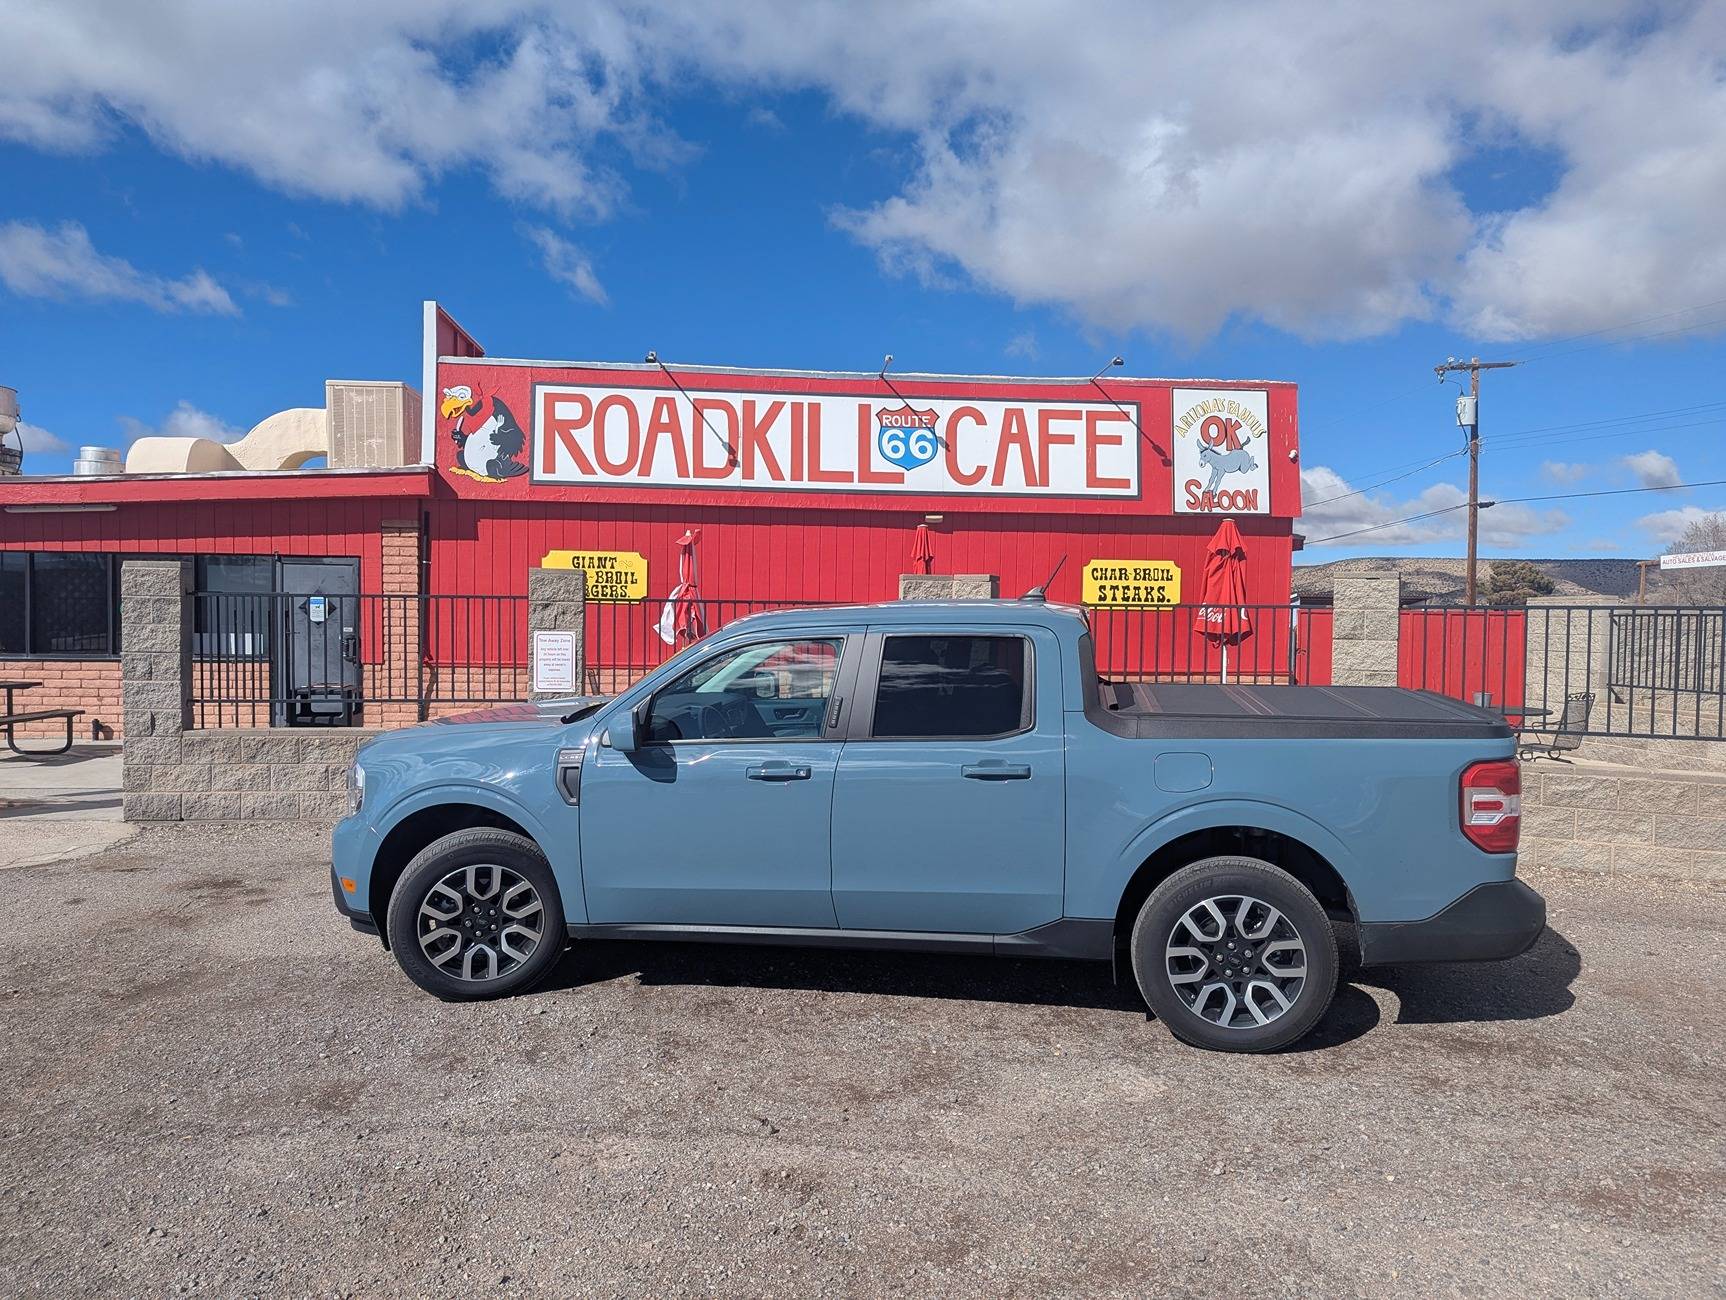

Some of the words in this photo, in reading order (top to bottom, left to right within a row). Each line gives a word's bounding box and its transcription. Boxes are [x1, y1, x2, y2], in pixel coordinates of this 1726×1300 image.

[882, 415, 931, 427] ROUTE
[1200, 415, 1243, 451] OK
[1227, 400, 1267, 438] FAMOUS
[543, 392, 904, 483] ROADKILL
[945, 405, 1131, 489] CAFE
[881, 429, 935, 460] 66
[1184, 479, 1259, 512] SALOON
[572, 556, 617, 569] GIANT
[1098, 585, 1171, 603] STEAKS.
